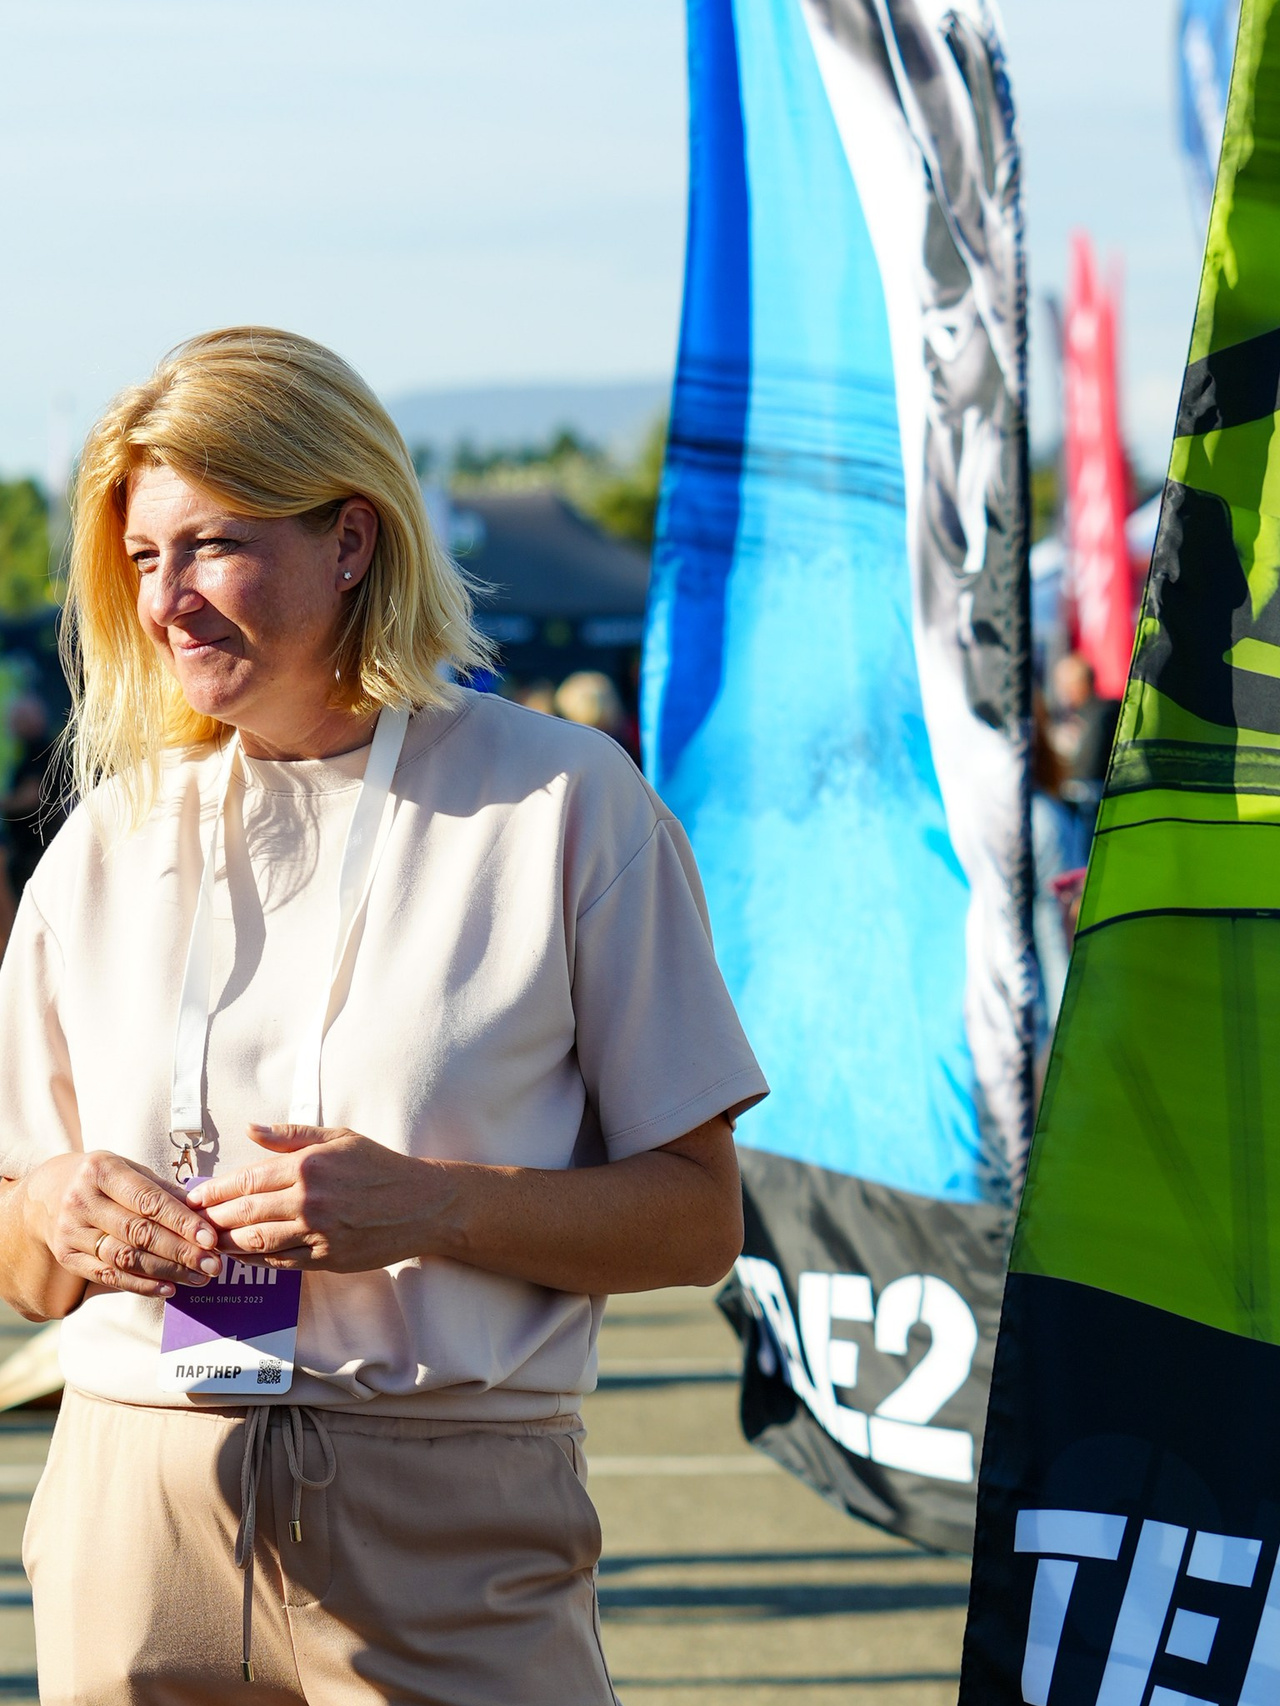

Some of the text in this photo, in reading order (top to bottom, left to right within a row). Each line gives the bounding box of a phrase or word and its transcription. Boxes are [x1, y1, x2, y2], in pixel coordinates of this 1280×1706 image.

[190, 1295, 264, 1304] SOCHI SIRIUS 2023
[175, 1364, 242, 1379] ПАРТНЕР
